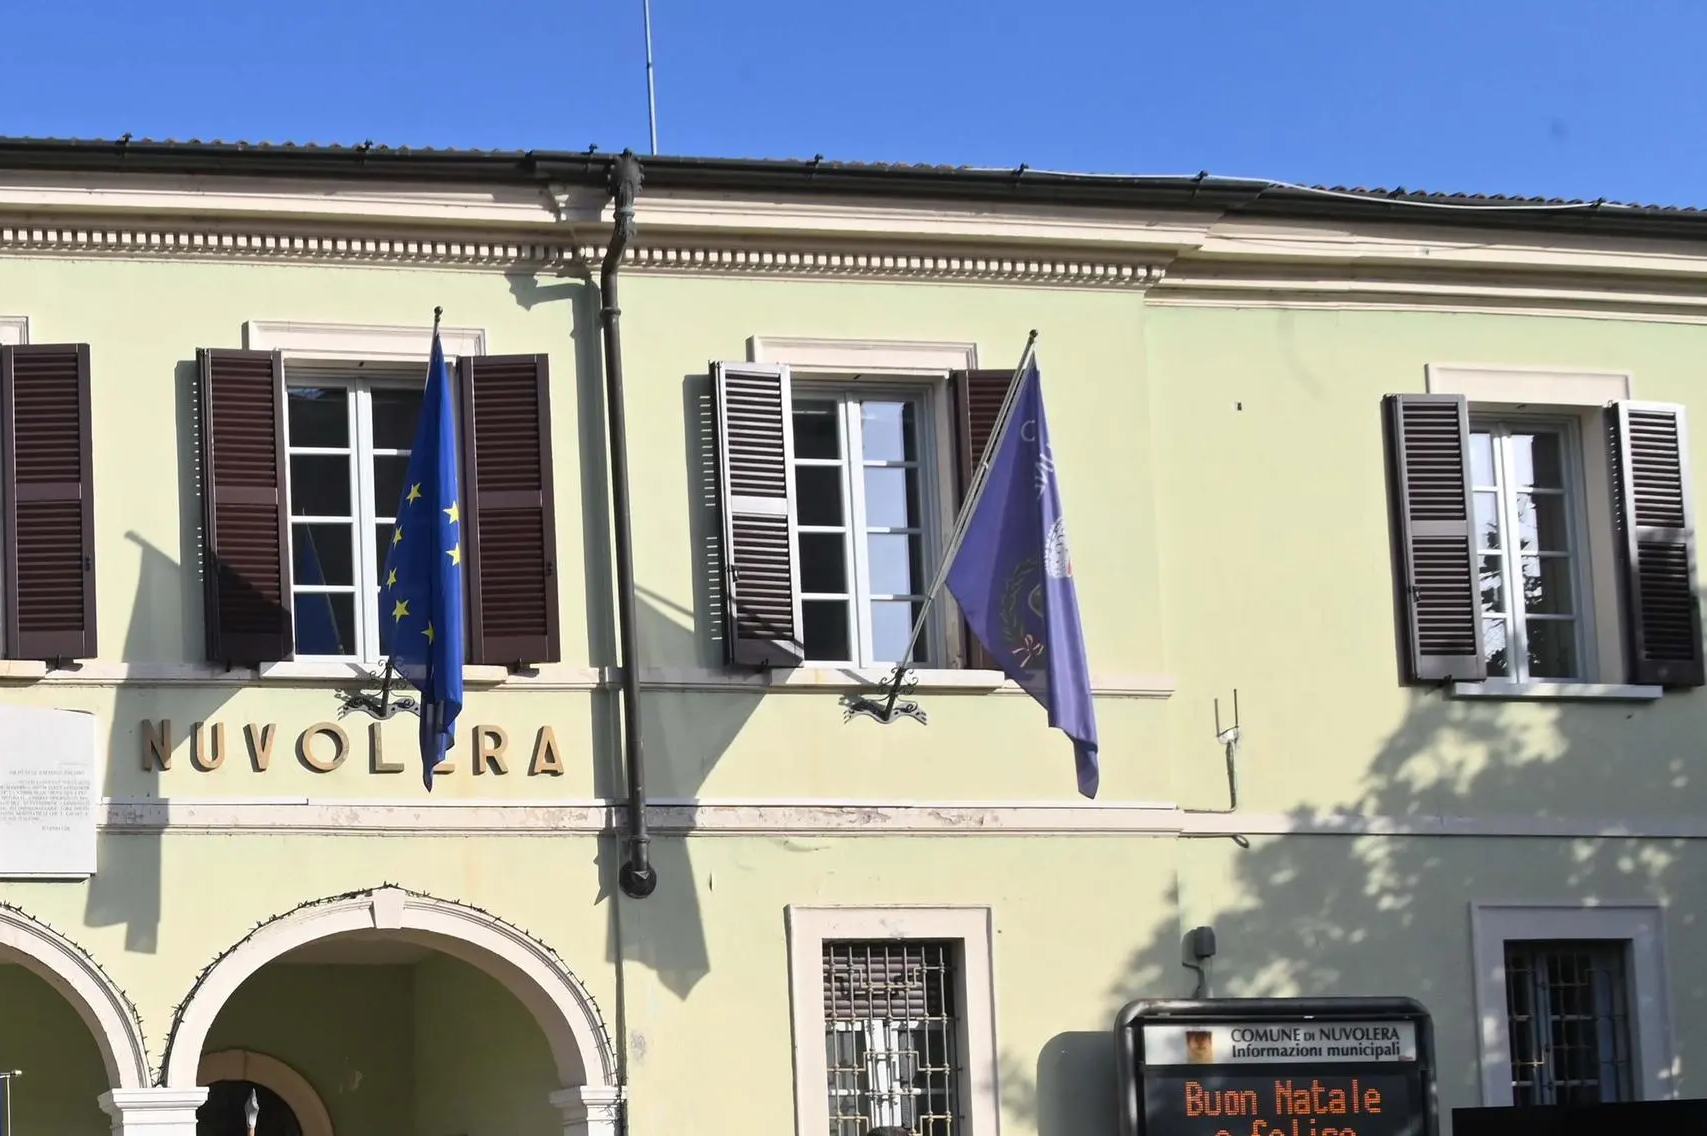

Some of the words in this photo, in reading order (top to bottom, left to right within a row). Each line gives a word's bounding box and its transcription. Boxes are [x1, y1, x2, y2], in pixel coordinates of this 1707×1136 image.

[141, 718, 565, 778] NUVOLRA
[1231, 1028, 1301, 1042] COMUNE
[1304, 1032, 1315, 1041] DI
[1319, 1027, 1401, 1041] NUVOLERA
[1232, 1043, 1322, 1058] Informazioni
[1327, 1041, 1401, 1060] municipali
[1185, 1081, 1258, 1117] Buon
[1274, 1079, 1382, 1115] Natale
